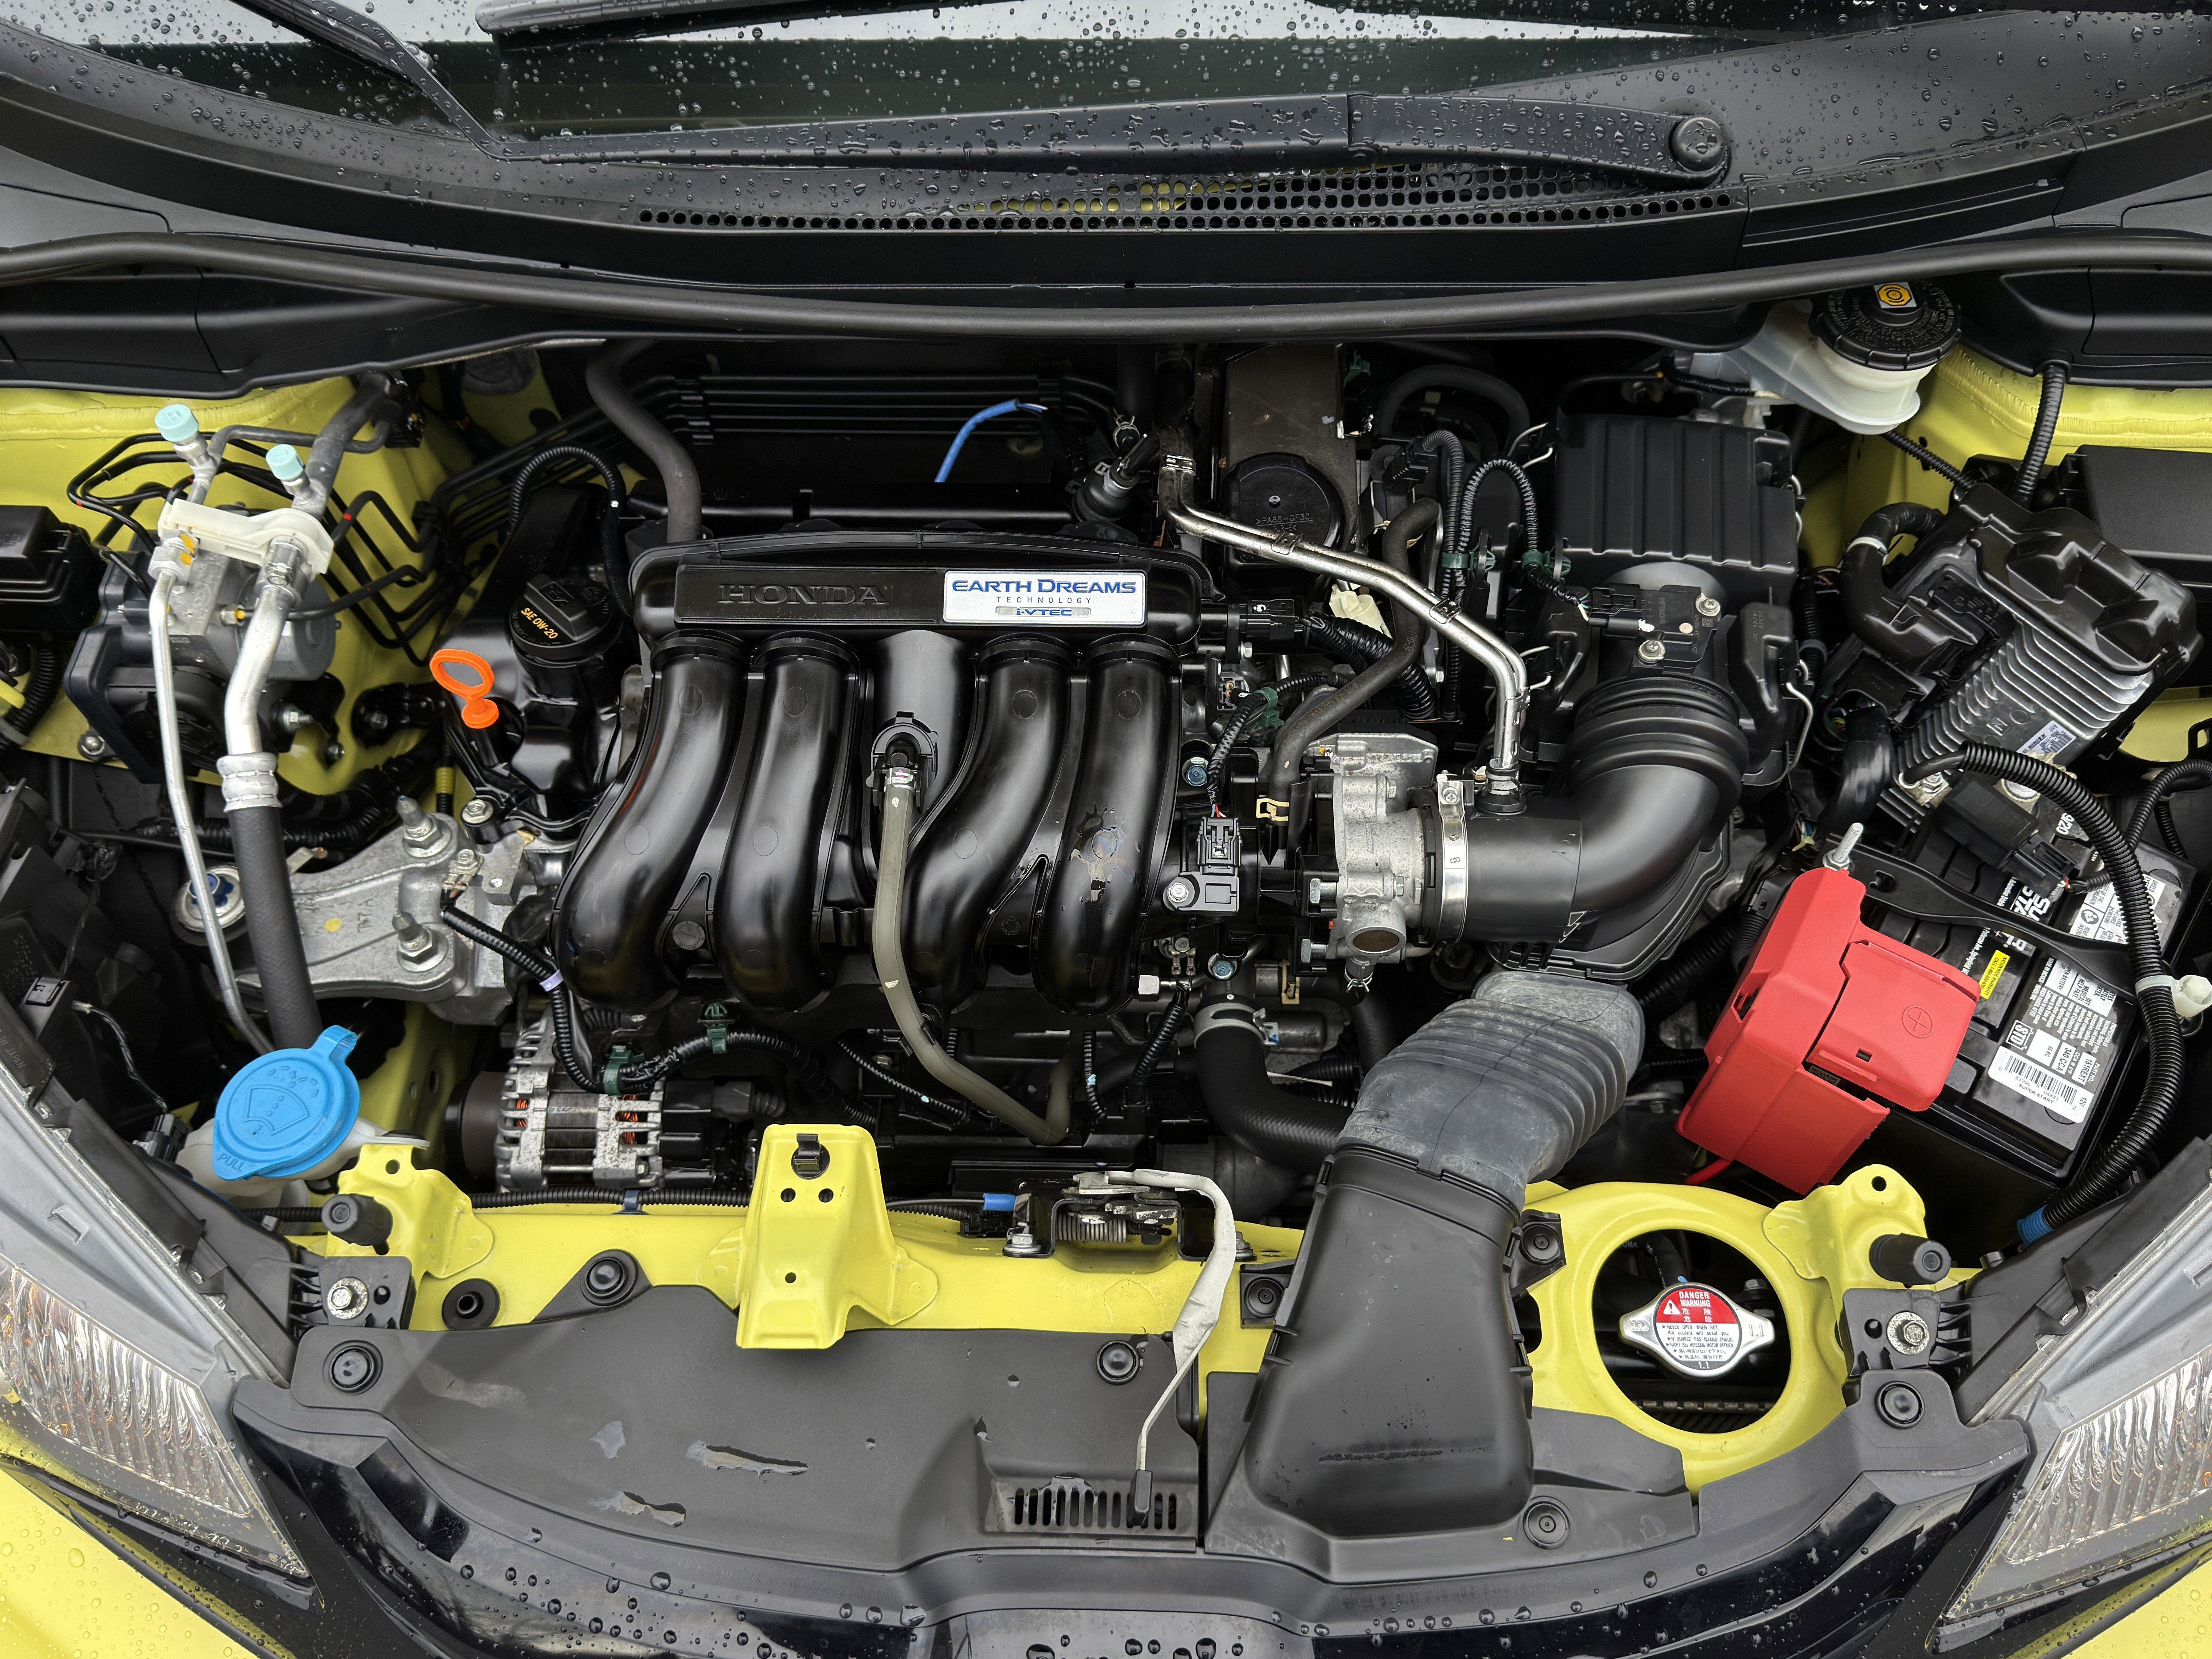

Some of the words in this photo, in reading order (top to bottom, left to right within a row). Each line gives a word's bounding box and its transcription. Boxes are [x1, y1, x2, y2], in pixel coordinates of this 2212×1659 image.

[952, 579, 1032, 592] EARTH
[1037, 579, 1136, 593] DREAMS
[718, 584, 890, 605] HONDA
[1016, 607, 1072, 616] i-VTEC
[521, 608, 537, 620] SAE
[532, 618, 558, 639] 0W-20
[2148, 879, 2158, 892] SHIELD
[2075, 923, 2084, 936] INSTRU
[2082, 926, 2090, 936] READ
[1993, 957, 2007, 977] NATIONWIDE
[1984, 977, 1997, 996] WARRANTY
[2056, 974, 2068, 991] BATTERY.
[2076, 978, 2085, 988] HELP
[2038, 987, 2047, 998] WASH
[2071, 988, 2081, 999] FAST.
[2077, 985, 2089, 1002] MEDICAL
[2093, 986, 2103, 998] ATER.
[2033, 996, 2043, 1008] HANDS
[2083, 997, 2091, 1005] GET
[2029, 1006, 2038, 1017] AFTER
[2009, 1023, 2029, 1045] STD
[2103, 1022, 2117, 1043] PROPOSITION
[2062, 1047, 2072, 1058] 340
[2071, 1051, 2080, 1062] CCA
[2056, 1058, 2067, 1072] CCA
[2091, 1062, 2101, 1075] PART
[2018, 1083, 2036, 1094] SUPER
[2036, 1093, 2054, 1104] START
[2078, 1096, 2087, 1107] 12V
[217, 1152, 245, 1172] PULL
[1698, 1361, 1710, 1370] 1.1
